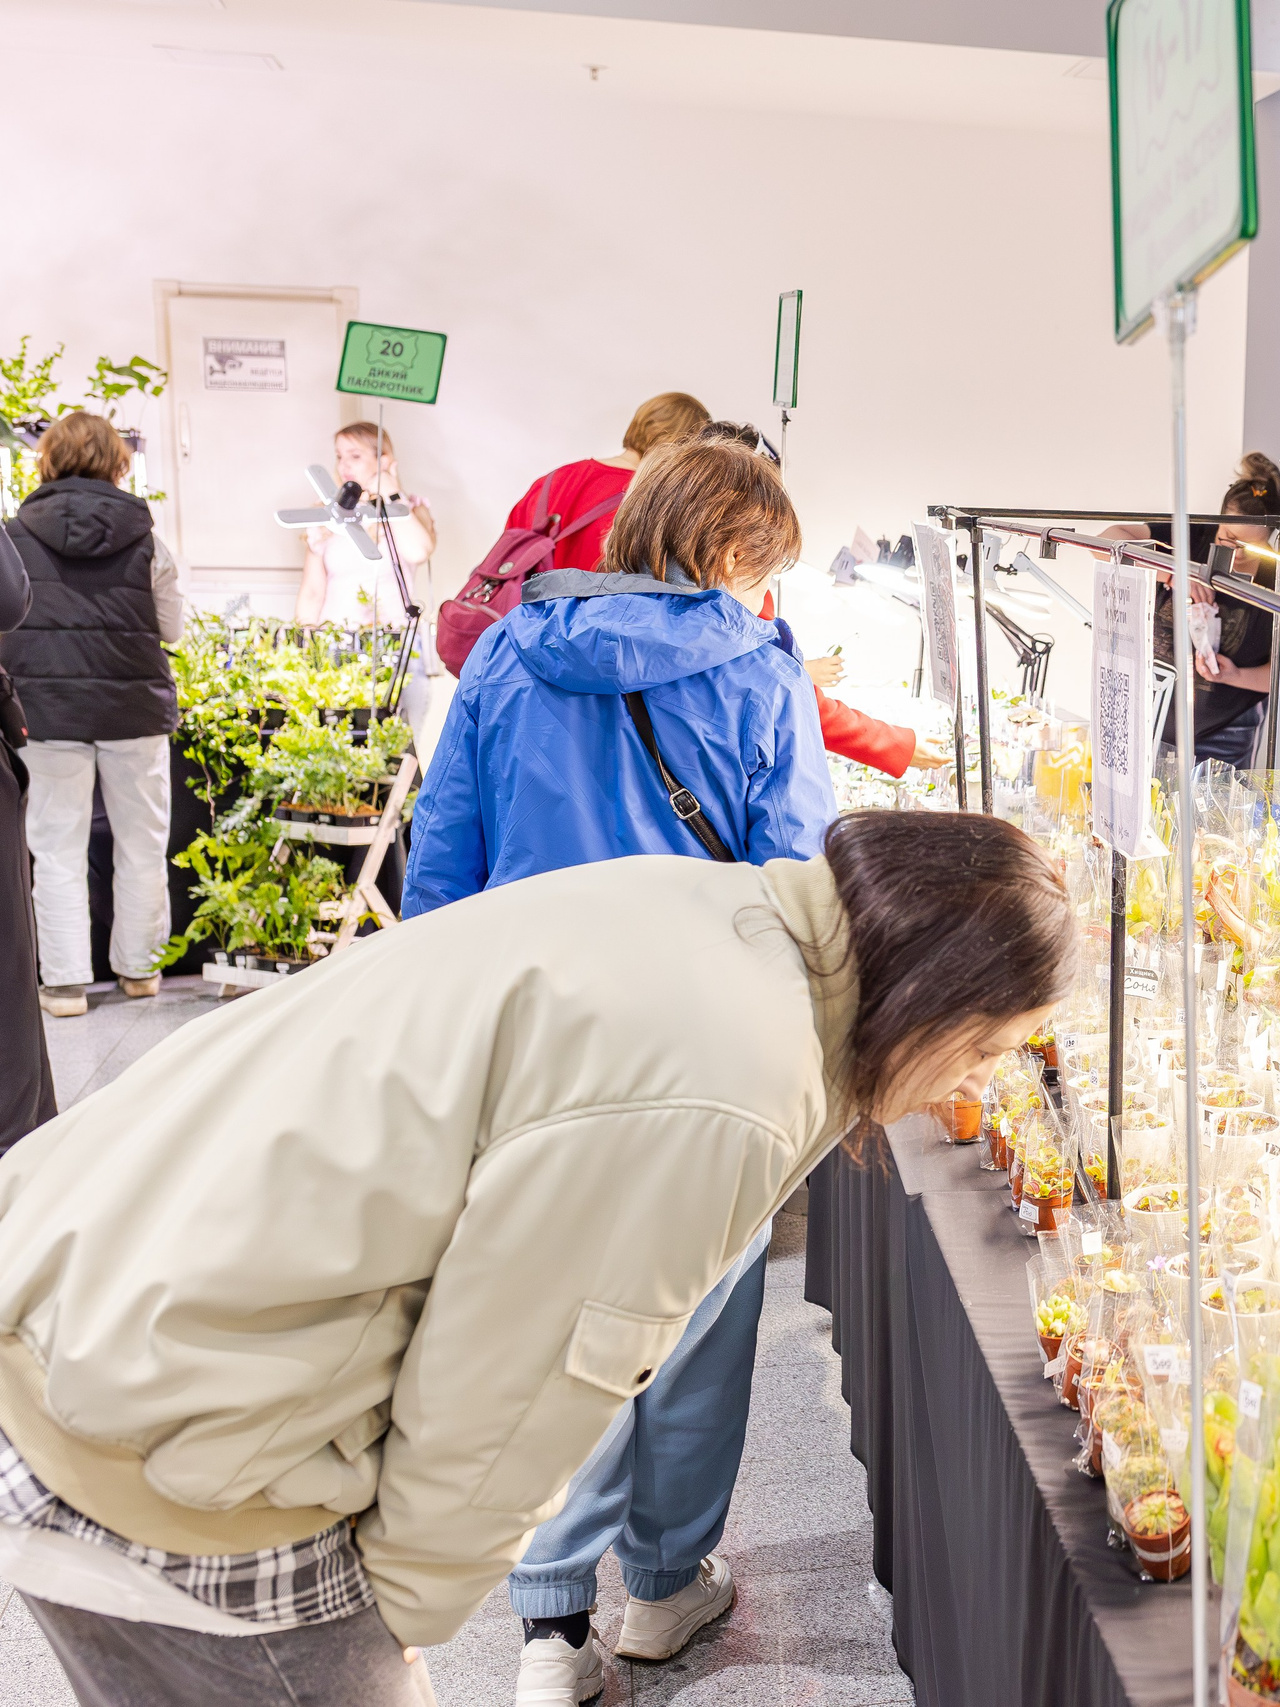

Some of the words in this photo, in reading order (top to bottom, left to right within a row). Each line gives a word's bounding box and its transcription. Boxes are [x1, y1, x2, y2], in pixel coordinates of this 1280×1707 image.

[380, 340, 404, 357] 20
[368, 367, 408, 381] ДИКИЙ
[346, 376, 424, 395] ПАПОРОТНИК
